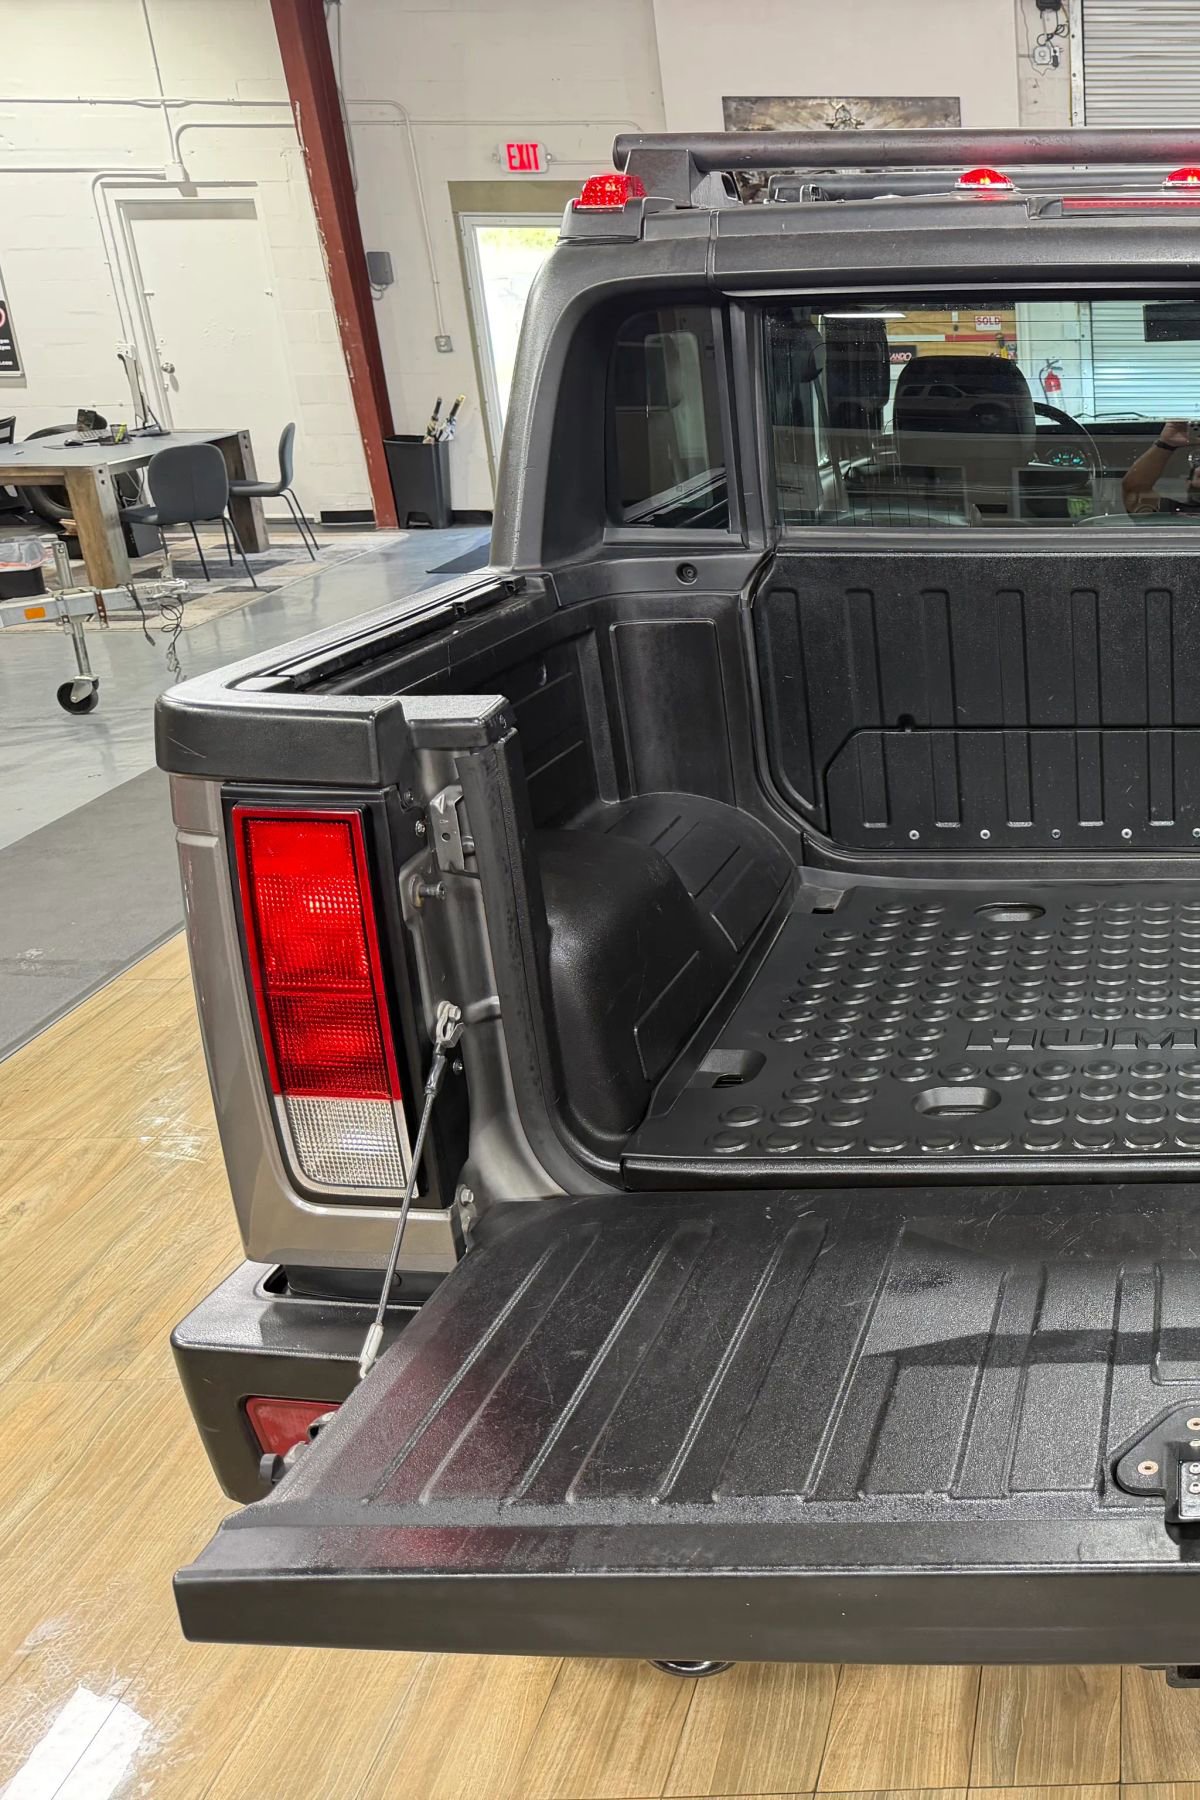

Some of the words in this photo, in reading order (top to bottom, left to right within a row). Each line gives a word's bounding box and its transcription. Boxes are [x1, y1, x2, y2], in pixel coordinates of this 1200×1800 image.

[506, 143, 540, 170] EXIT
[975, 316, 1001, 326] SOLD
[888, 351, 913, 361] ANDO
